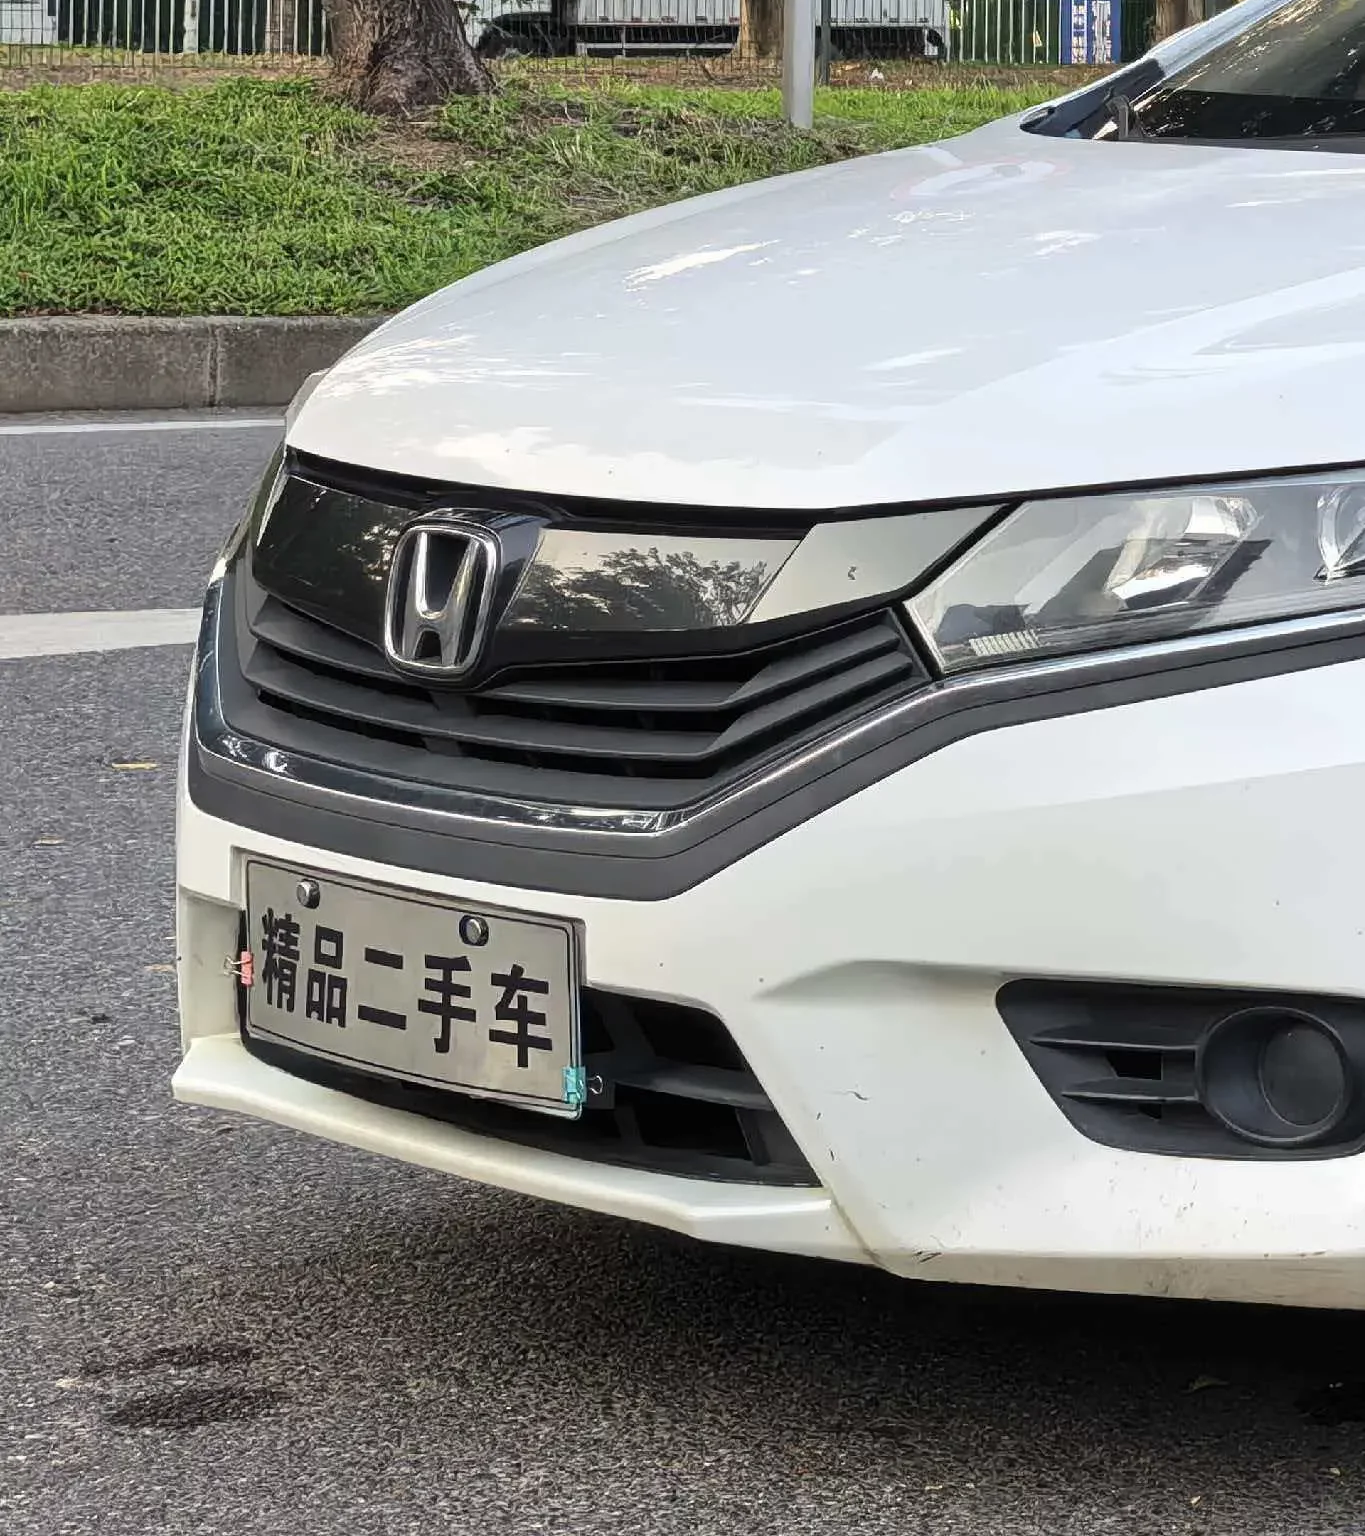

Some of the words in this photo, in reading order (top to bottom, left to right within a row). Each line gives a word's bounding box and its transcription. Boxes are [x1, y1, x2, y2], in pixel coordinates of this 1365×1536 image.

[261, 906, 552, 1068] 精品二手车
